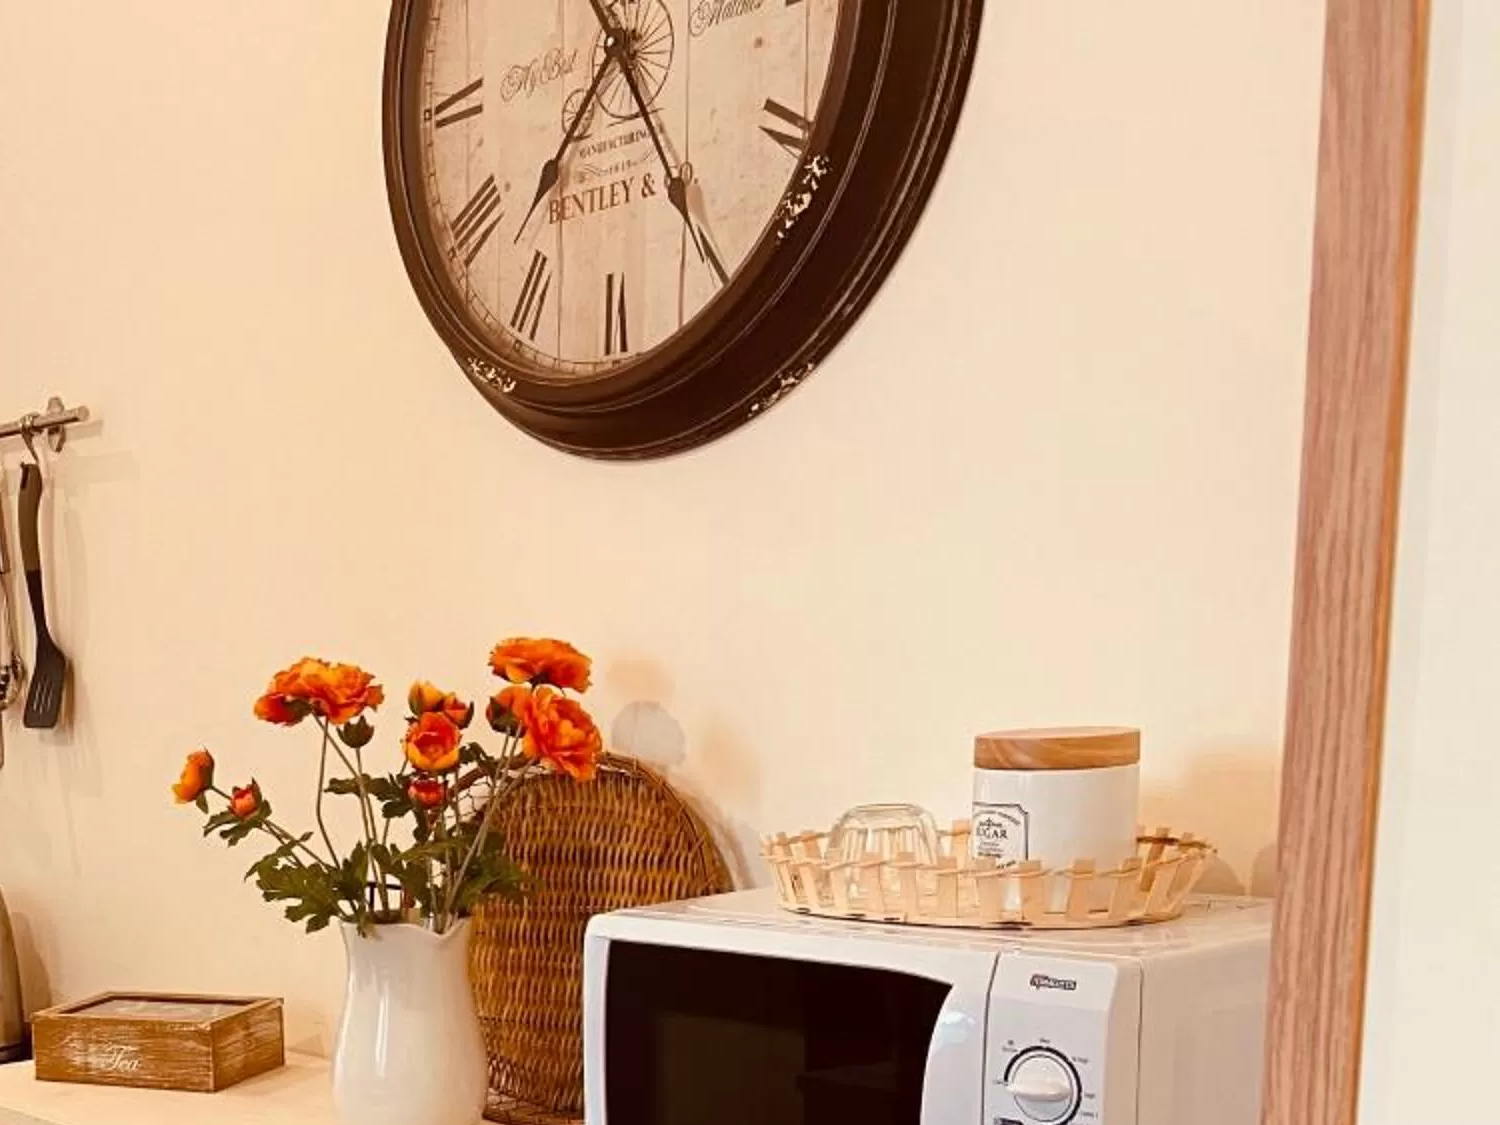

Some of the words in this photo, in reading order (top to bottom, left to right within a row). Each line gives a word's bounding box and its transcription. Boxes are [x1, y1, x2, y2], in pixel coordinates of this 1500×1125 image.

[548, 174, 634, 225] BENTLEY
[641, 172, 656, 199] &
[105, 1045, 141, 1073] Tea
